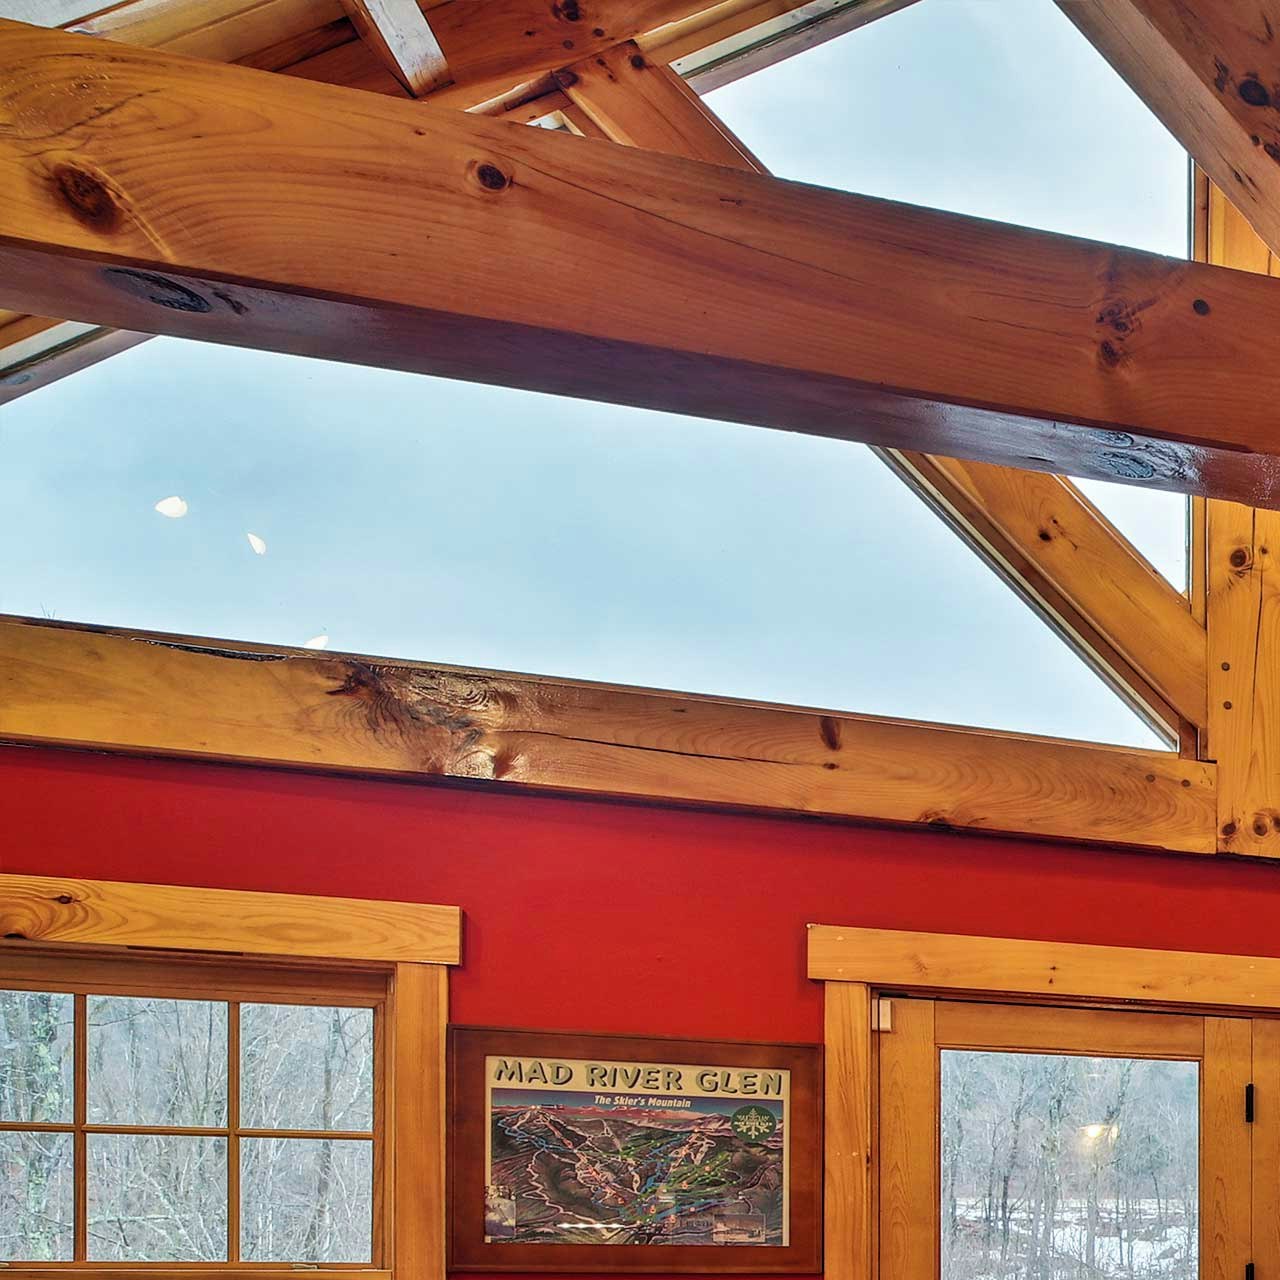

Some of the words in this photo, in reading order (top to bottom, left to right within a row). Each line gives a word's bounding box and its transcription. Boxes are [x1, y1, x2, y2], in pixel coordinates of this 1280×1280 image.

[494, 1059, 573, 1085] MAD
[584, 1063, 683, 1091] RIVER
[695, 1069, 783, 1096] GLEN
[594, 1094, 612, 1105] The
[613, 1096, 646, 1106] Skier's
[648, 1097, 692, 1108] Mountain
